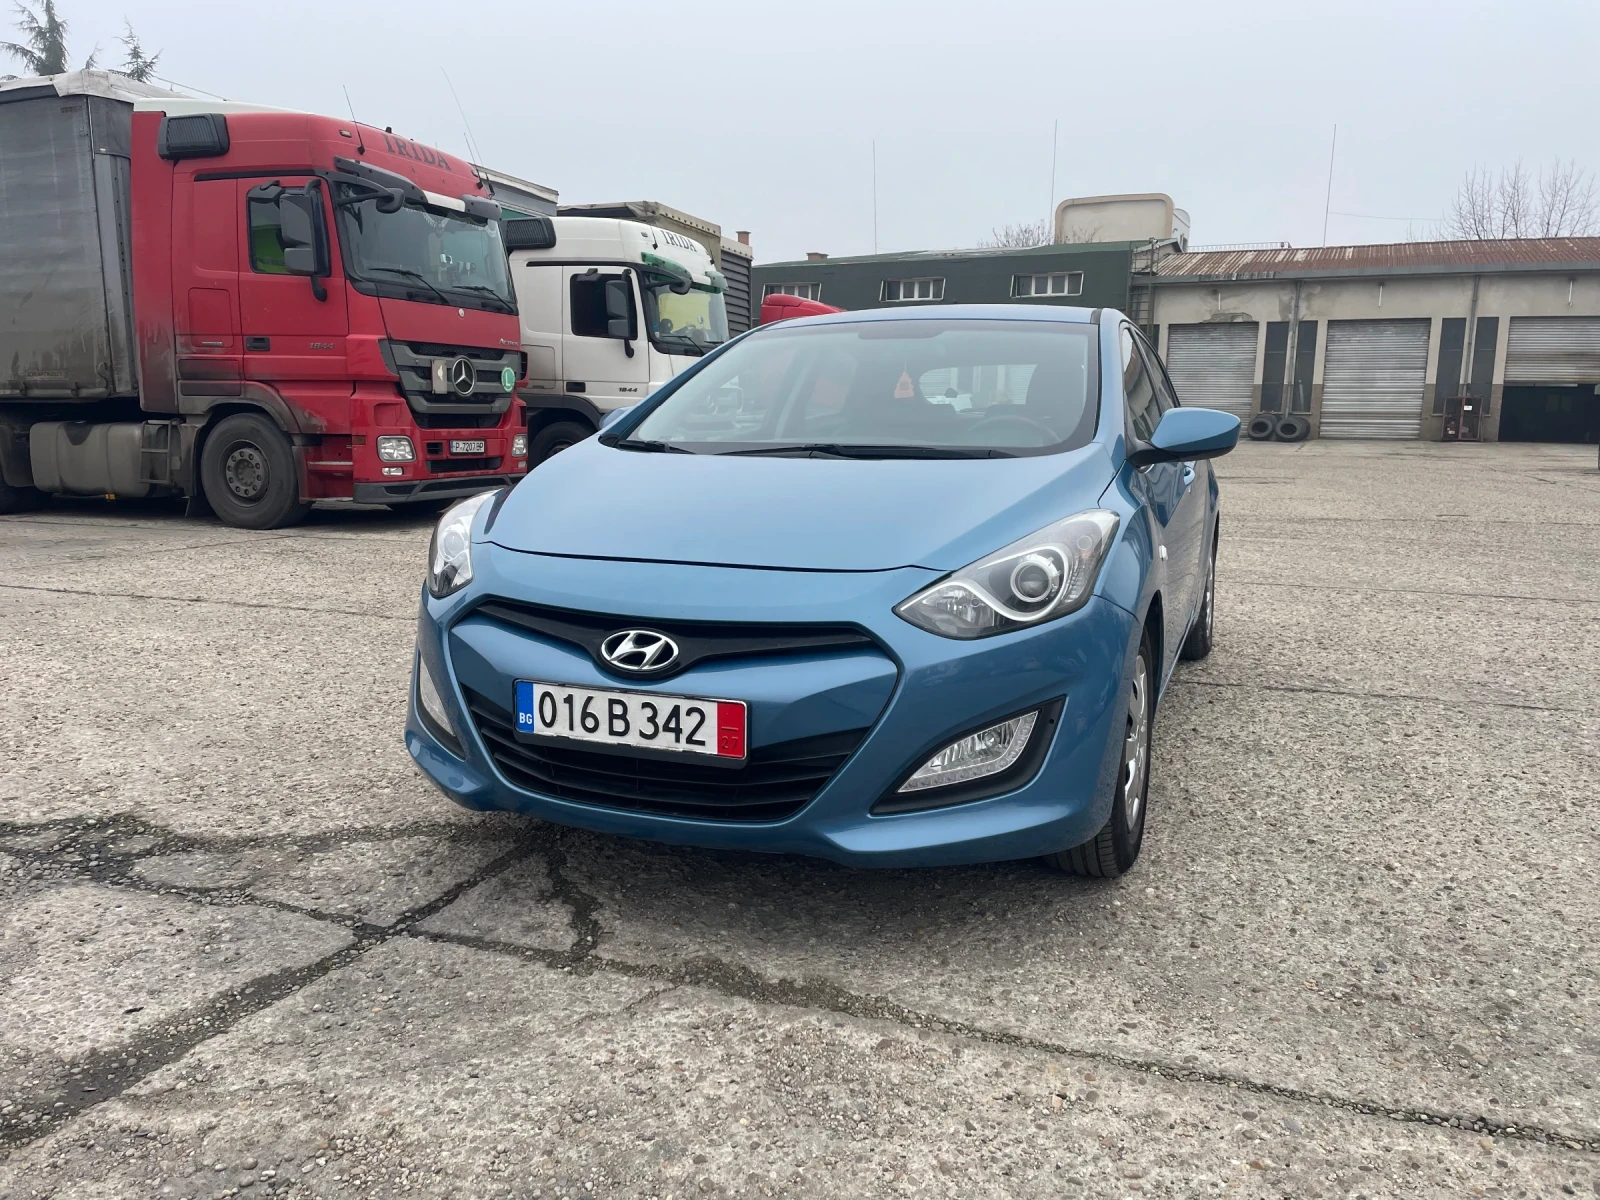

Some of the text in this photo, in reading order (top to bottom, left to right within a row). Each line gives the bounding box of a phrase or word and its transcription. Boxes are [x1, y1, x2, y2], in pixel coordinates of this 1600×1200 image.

[381, 133, 452, 171] IRIDA
[660, 229, 698, 253] IRIDA
[519, 711, 533, 725] BG
